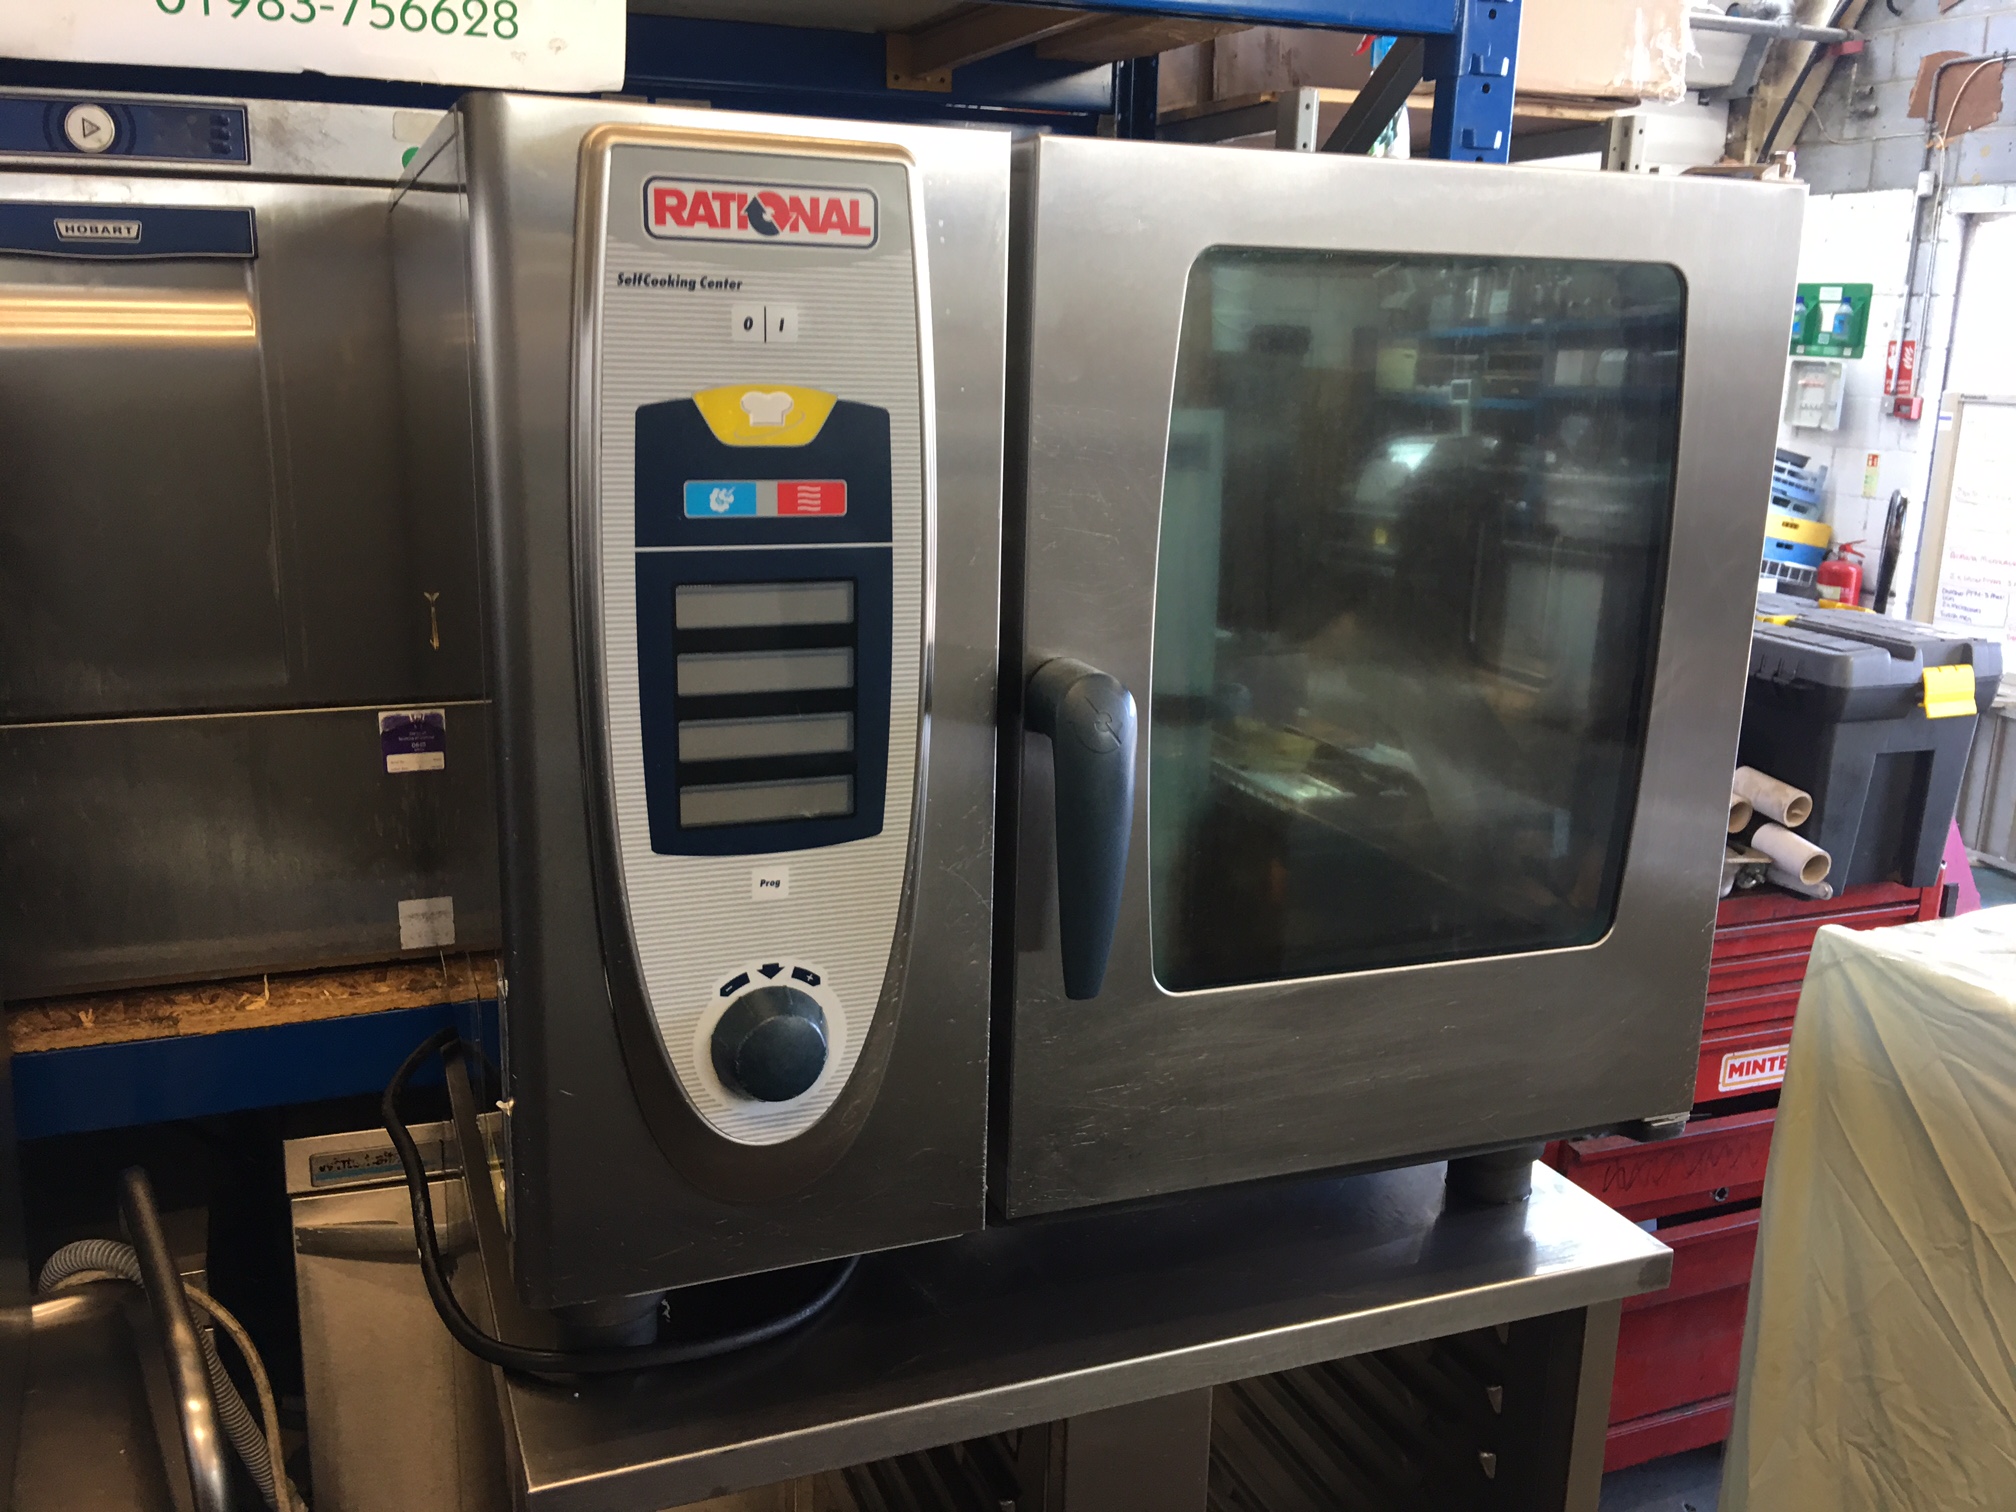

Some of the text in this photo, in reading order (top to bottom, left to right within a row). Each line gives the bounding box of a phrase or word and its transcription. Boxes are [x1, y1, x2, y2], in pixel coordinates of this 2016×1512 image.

[653, 186, 872, 237] RATIONAL
[64, 225, 132, 235] HOBART
[617, 272, 743, 292] SelfCooking Center
[760, 879, 781, 888] Prog
